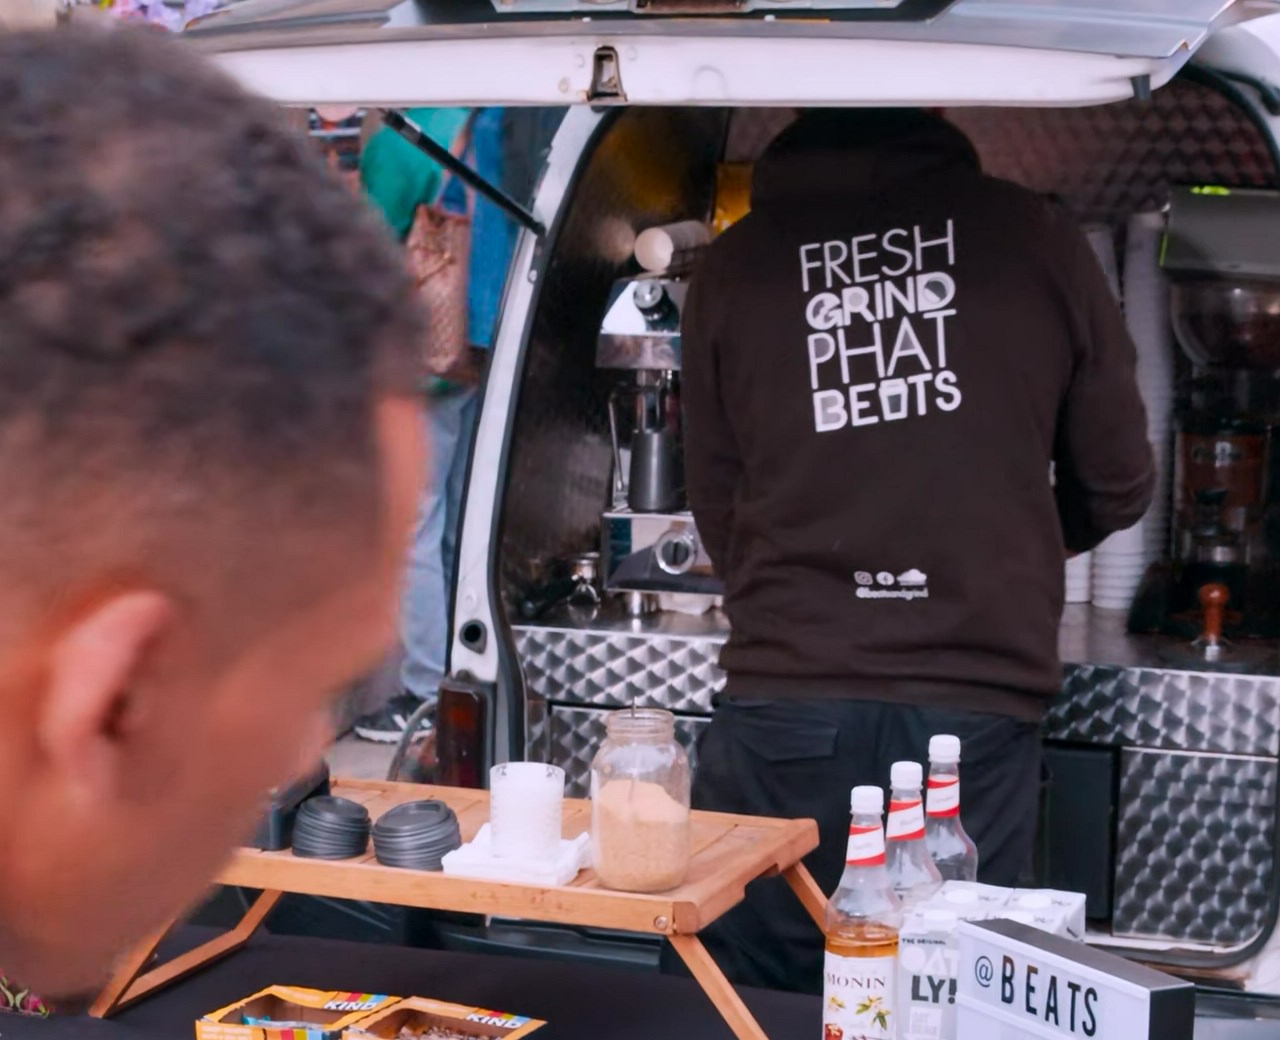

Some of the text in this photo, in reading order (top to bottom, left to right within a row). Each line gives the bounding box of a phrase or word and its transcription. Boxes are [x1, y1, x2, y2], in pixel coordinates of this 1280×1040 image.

[799, 219, 955, 292] FRESH
[806, 272, 956, 331] GRIND
[807, 309, 957, 389] PHAT
[827, 972, 886, 989] MONIN
[911, 974, 957, 1004] LY!
[324, 1000, 377, 1011] KIND
[465, 1013, 522, 1029] KIND
